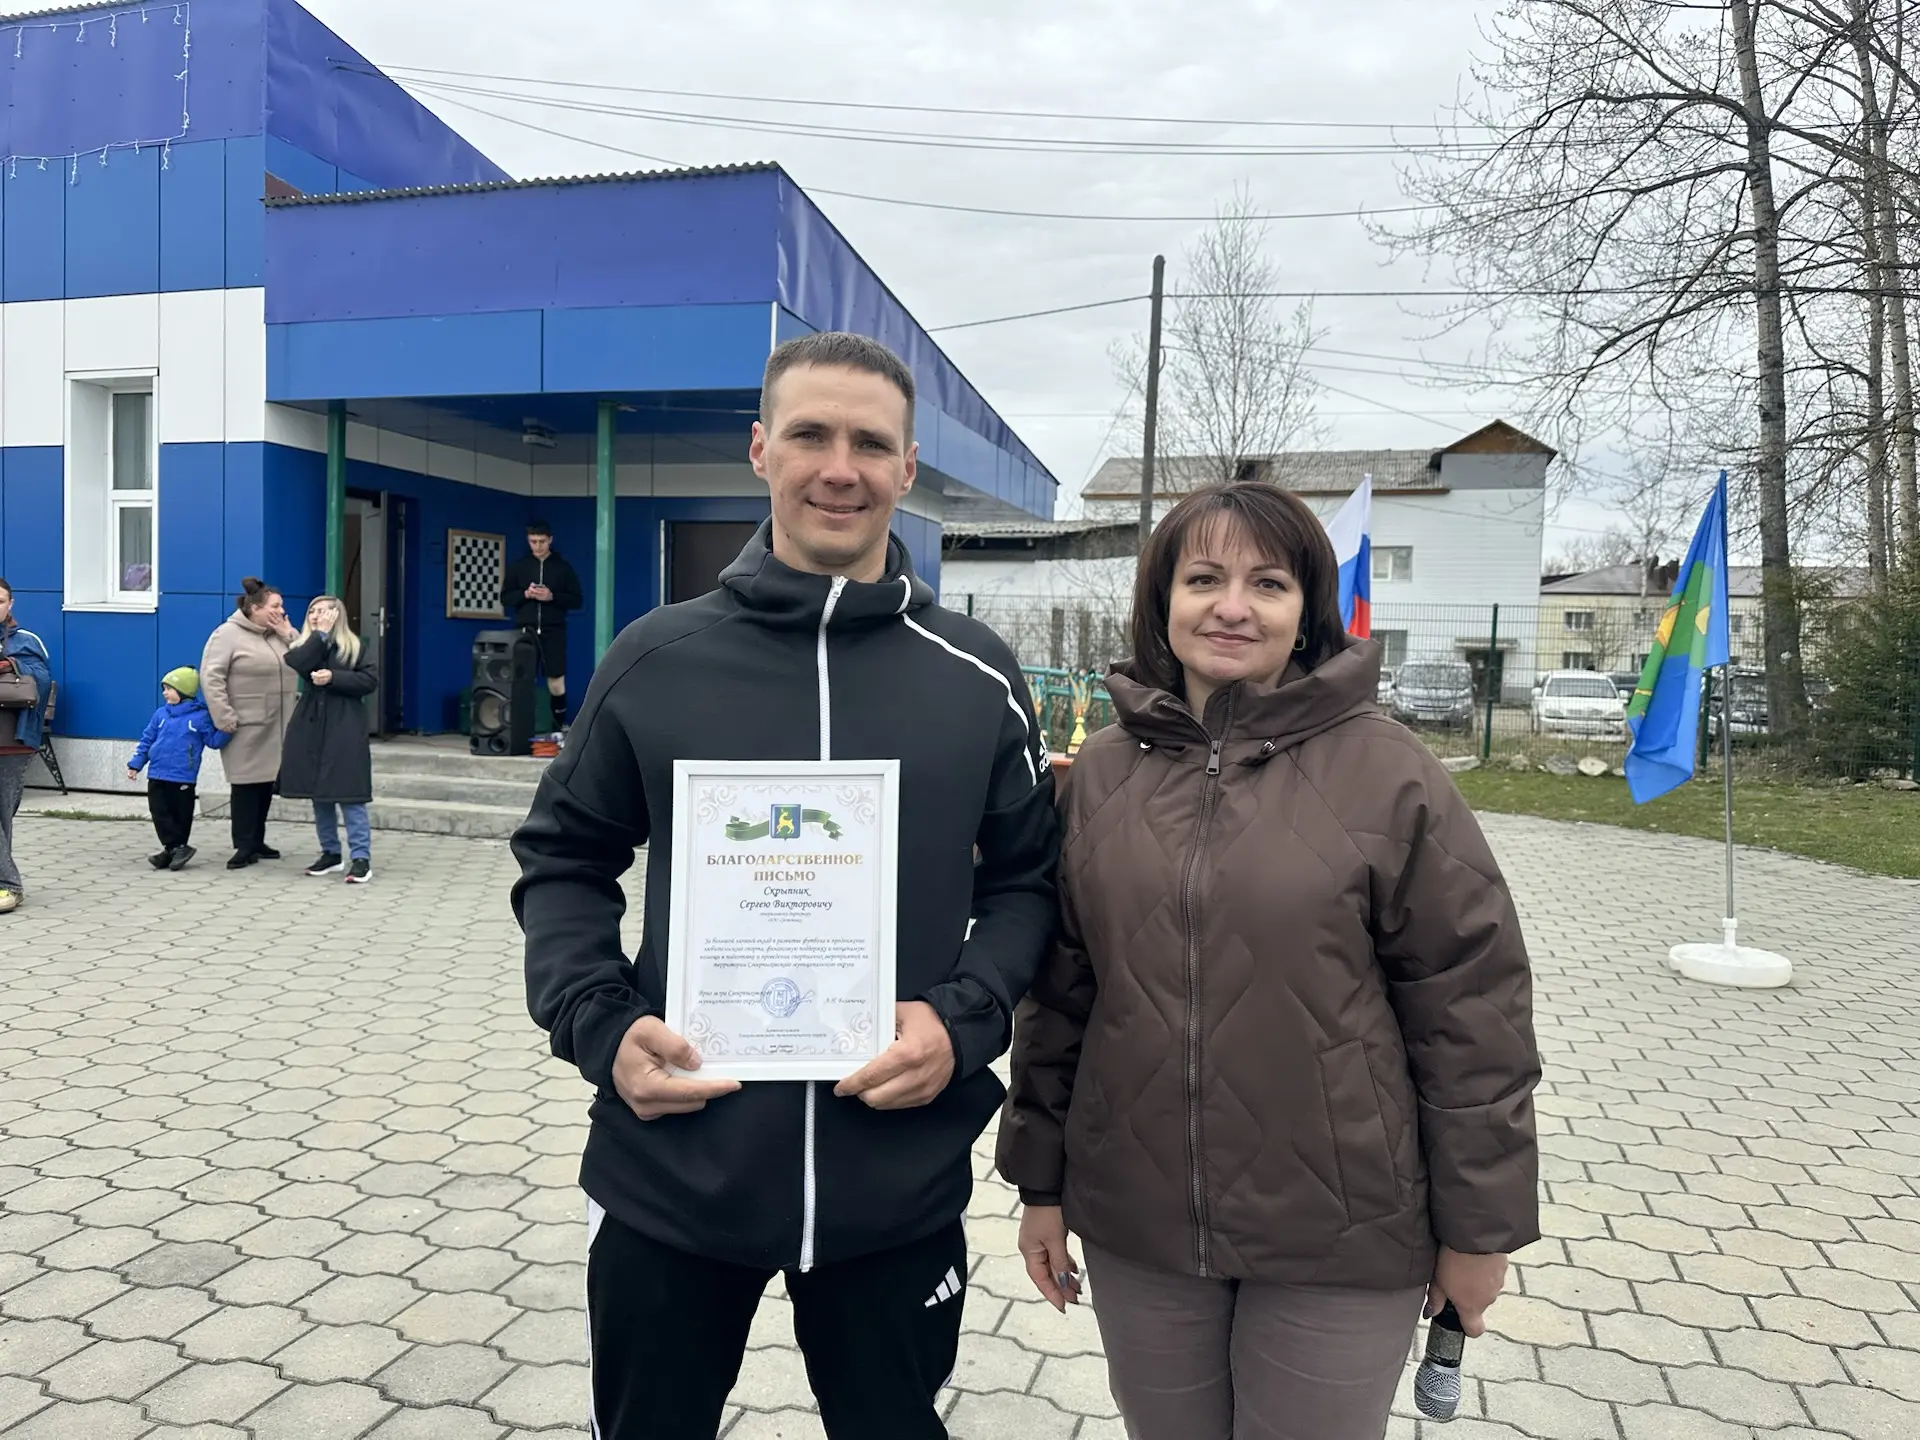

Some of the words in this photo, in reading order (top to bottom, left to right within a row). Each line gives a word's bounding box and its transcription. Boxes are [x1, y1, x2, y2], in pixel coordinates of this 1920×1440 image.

[706, 853, 864, 867] БЛАГОДАРСТВЕННОЕ
[753, 870, 816, 882] ПИСЬМО
[763, 886, 812, 898] Скрыпник
[739, 899, 771, 911] Сергею
[773, 899, 833, 911] Викторовичу
